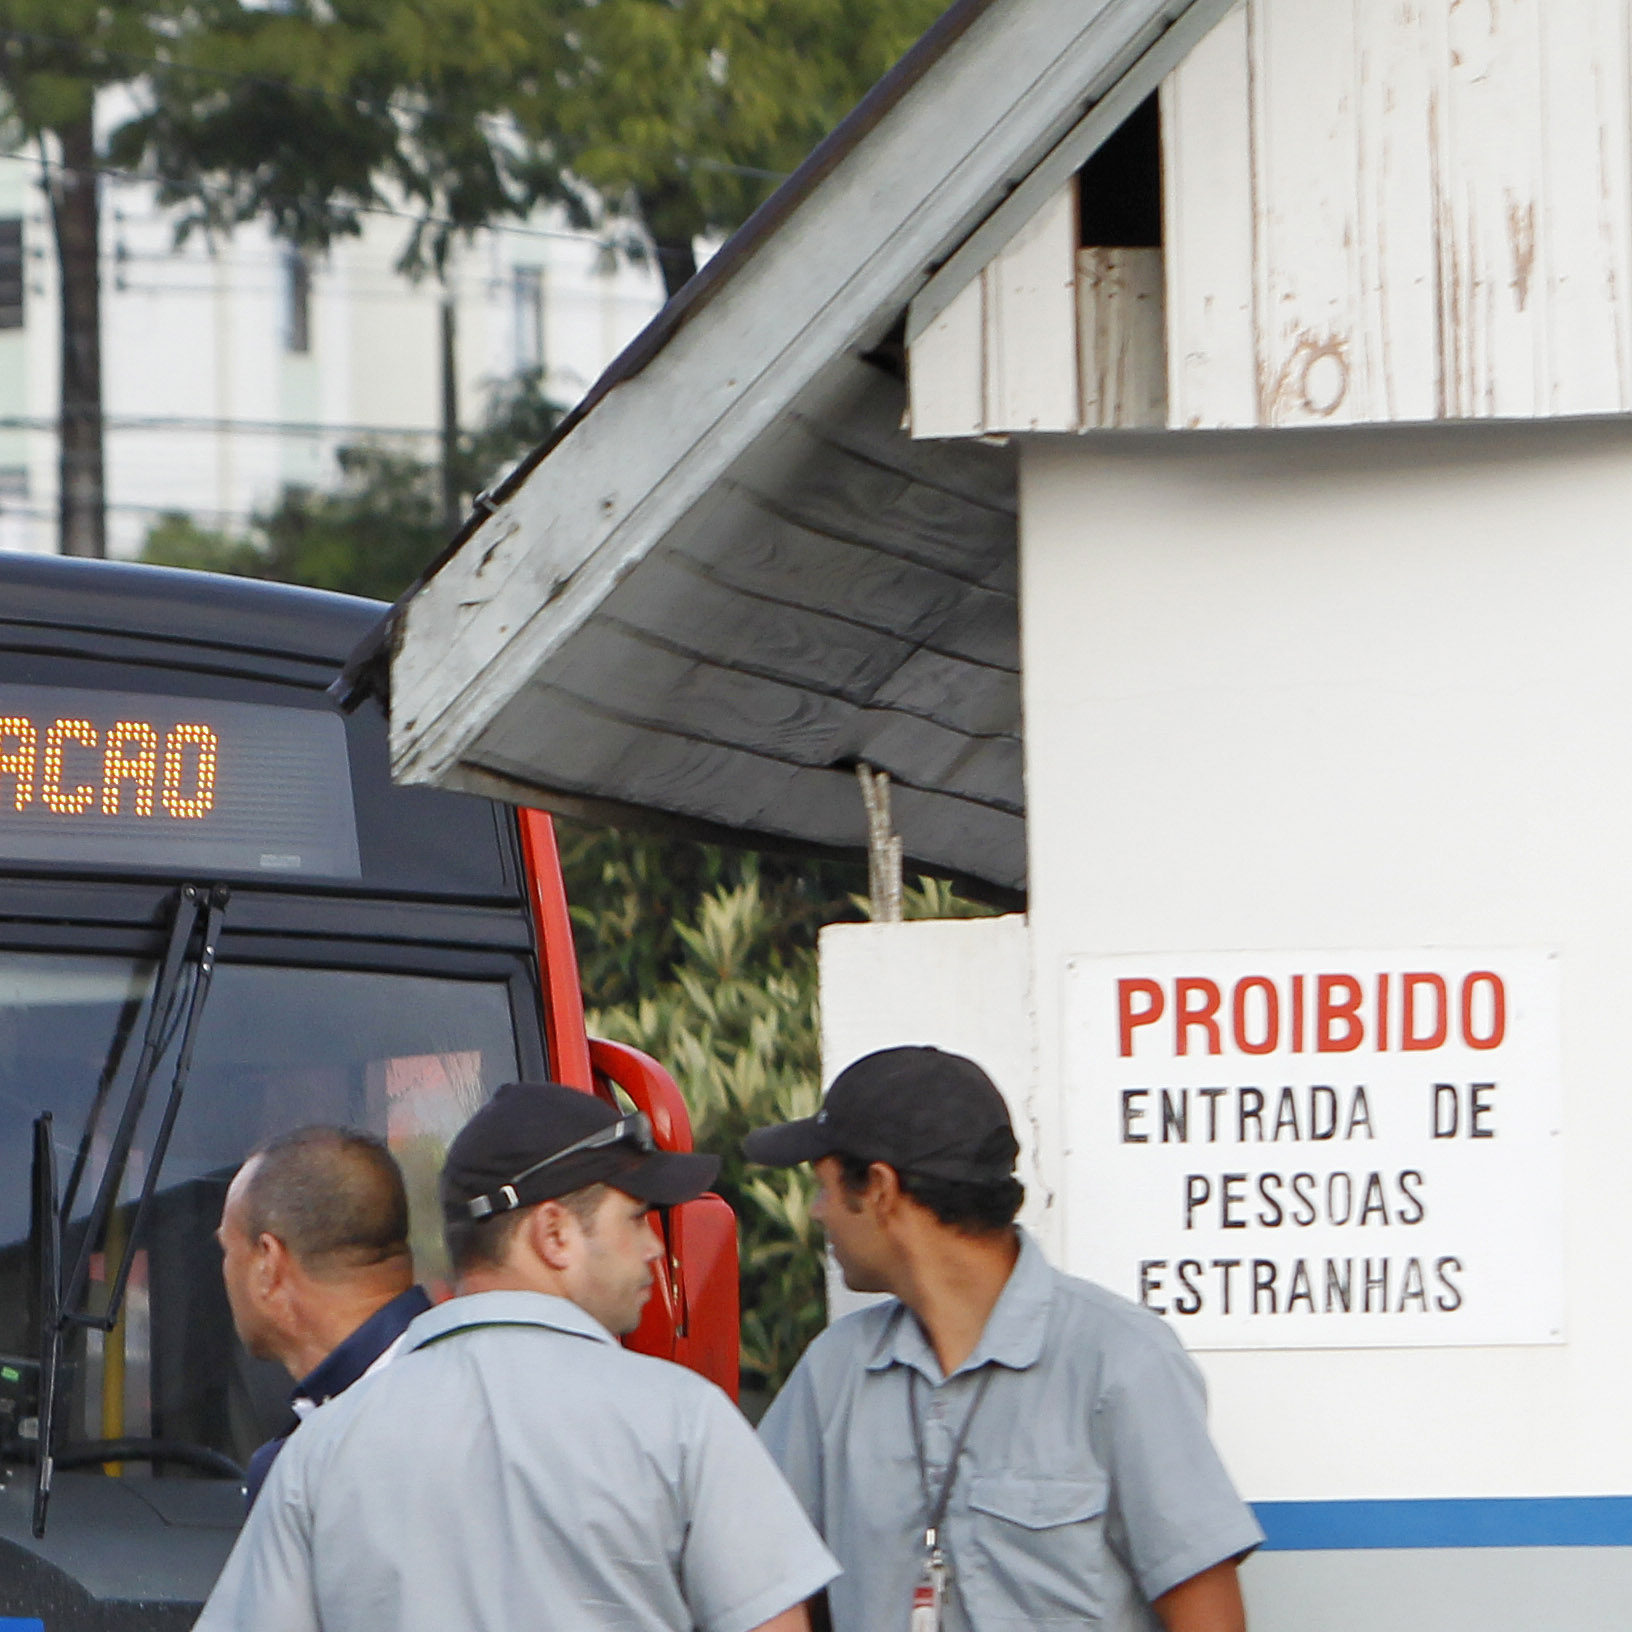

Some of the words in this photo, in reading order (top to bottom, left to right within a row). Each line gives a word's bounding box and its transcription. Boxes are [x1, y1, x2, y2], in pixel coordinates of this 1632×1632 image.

[1117, 971, 1507, 1058] PROIBIDO
[1120, 1084, 1374, 1144] ENTRADA
[1432, 1082, 1497, 1139] DE
[1185, 1169, 1425, 1230] PESSOAS
[1139, 1256, 1463, 1316] ESTRANHAS
